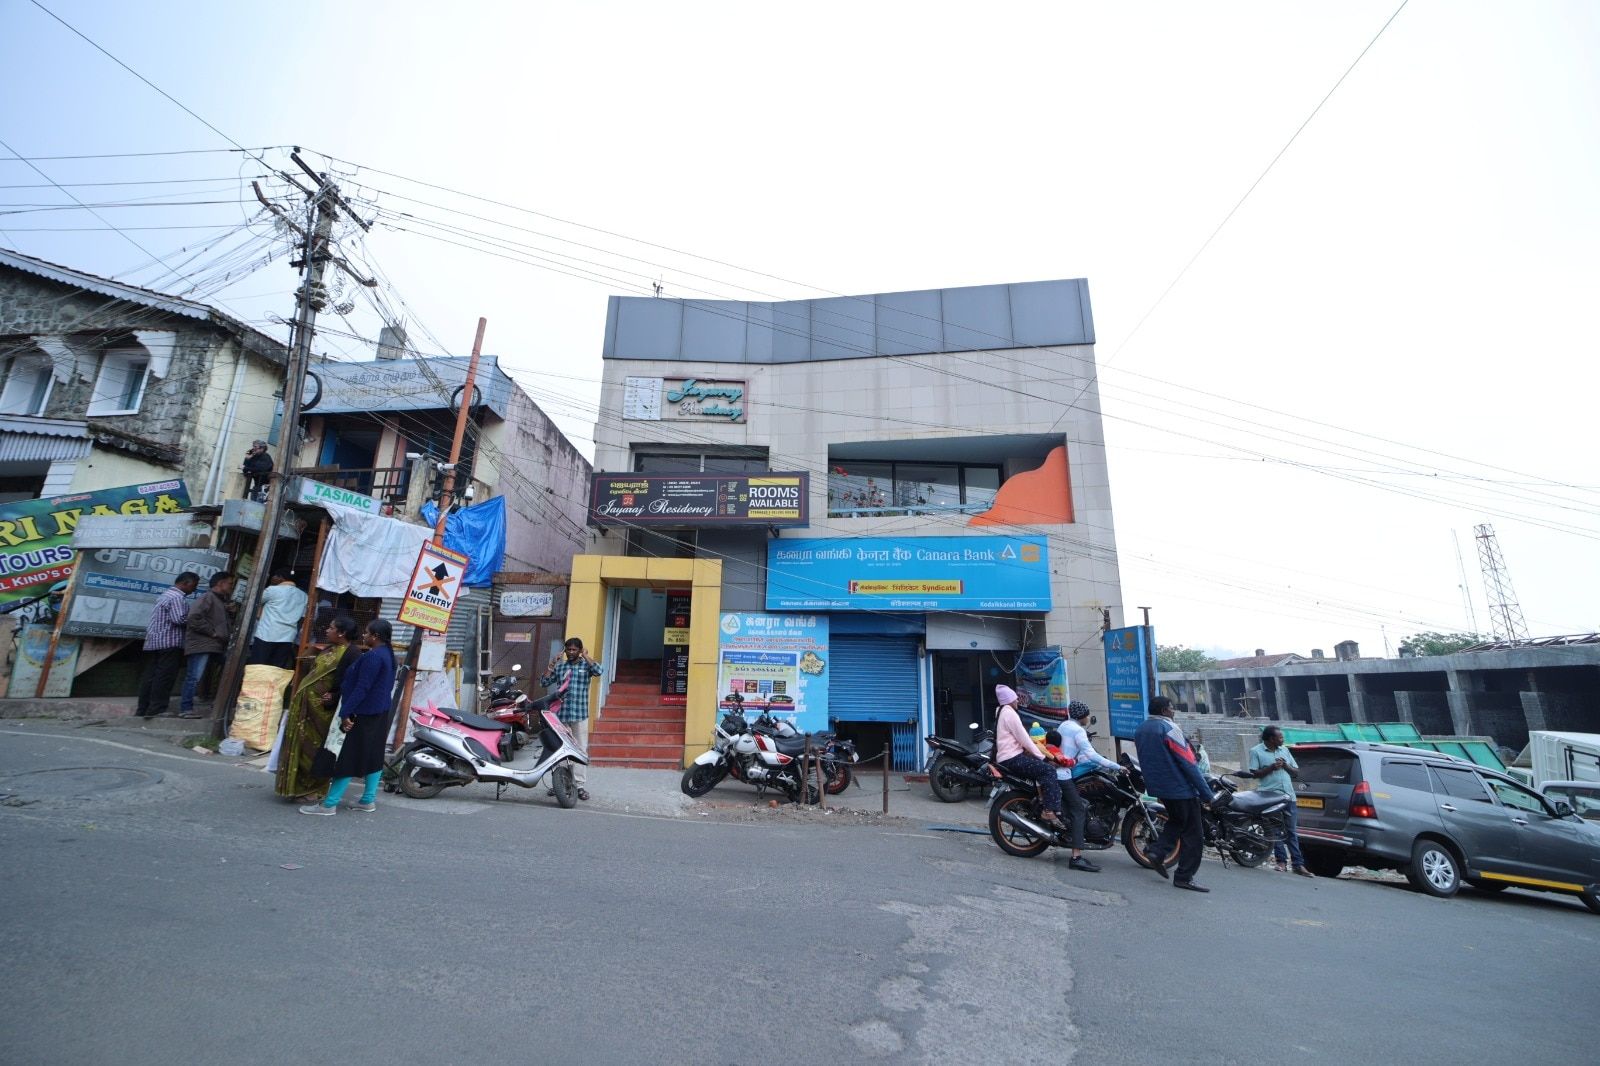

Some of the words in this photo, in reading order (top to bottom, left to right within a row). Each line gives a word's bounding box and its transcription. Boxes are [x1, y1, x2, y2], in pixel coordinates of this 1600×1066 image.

[314, 484, 372, 509] TASMAC
[749, 487, 798, 498] ROOMS
[597, 499, 646, 516] Jayaraj
[649, 498, 714, 517] Residency
[749, 499, 798, 508] AVAILABLE
[0, 545, 73, 575] TOURS
[776, 550, 812, 561] கனரா
[816, 547, 852, 560] வங்கி
[856, 547, 889, 561] केनरा
[893, 546, 911, 561] बैंक
[916, 548, 960, 561] Canara
[964, 548, 996, 561] Bank
[12, 569, 62, 586] KIND'S
[922, 584, 957, 593] Syndicate
[410, 589, 424, 600] NO
[424, 594, 452, 609] ENTRY
[745, 616, 780, 629] கனரா
[784, 615, 816, 628] வங்கி
